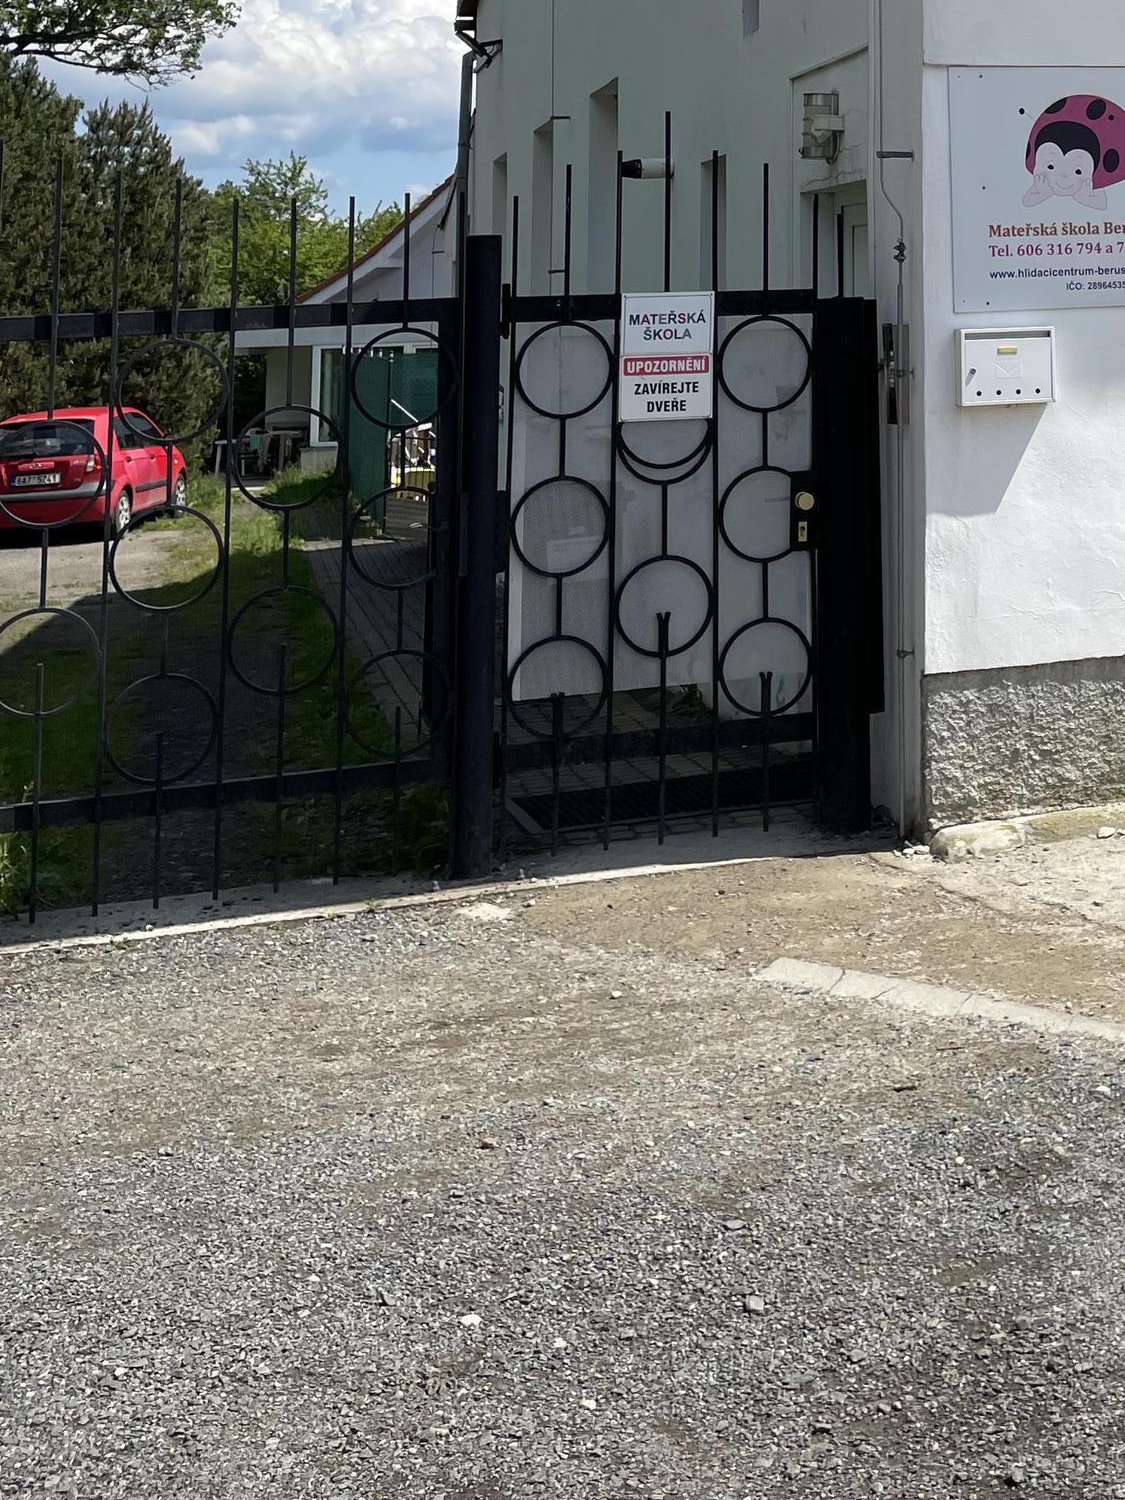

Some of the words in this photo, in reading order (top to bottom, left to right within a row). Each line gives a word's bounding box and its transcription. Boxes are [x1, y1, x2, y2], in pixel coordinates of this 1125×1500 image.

[988, 222, 1058, 238] Mateřská
[1061, 222, 1100, 236] škola
[988, 244, 1013, 257] Tel.
[1017, 243, 1043, 257] 606
[1046, 242, 1073, 256] 316
[1076, 242, 1103, 255] 794
[1105, 243, 1113, 254] a
[628, 309, 706, 326] MATEŘSKÁ
[643, 326, 692, 341] ŠKOLA
[626, 356, 706, 374] UPOZORNĚNÍ
[634, 380, 699, 396] ZAVÍREJTE
[646, 397, 687, 413] DVEŘE
